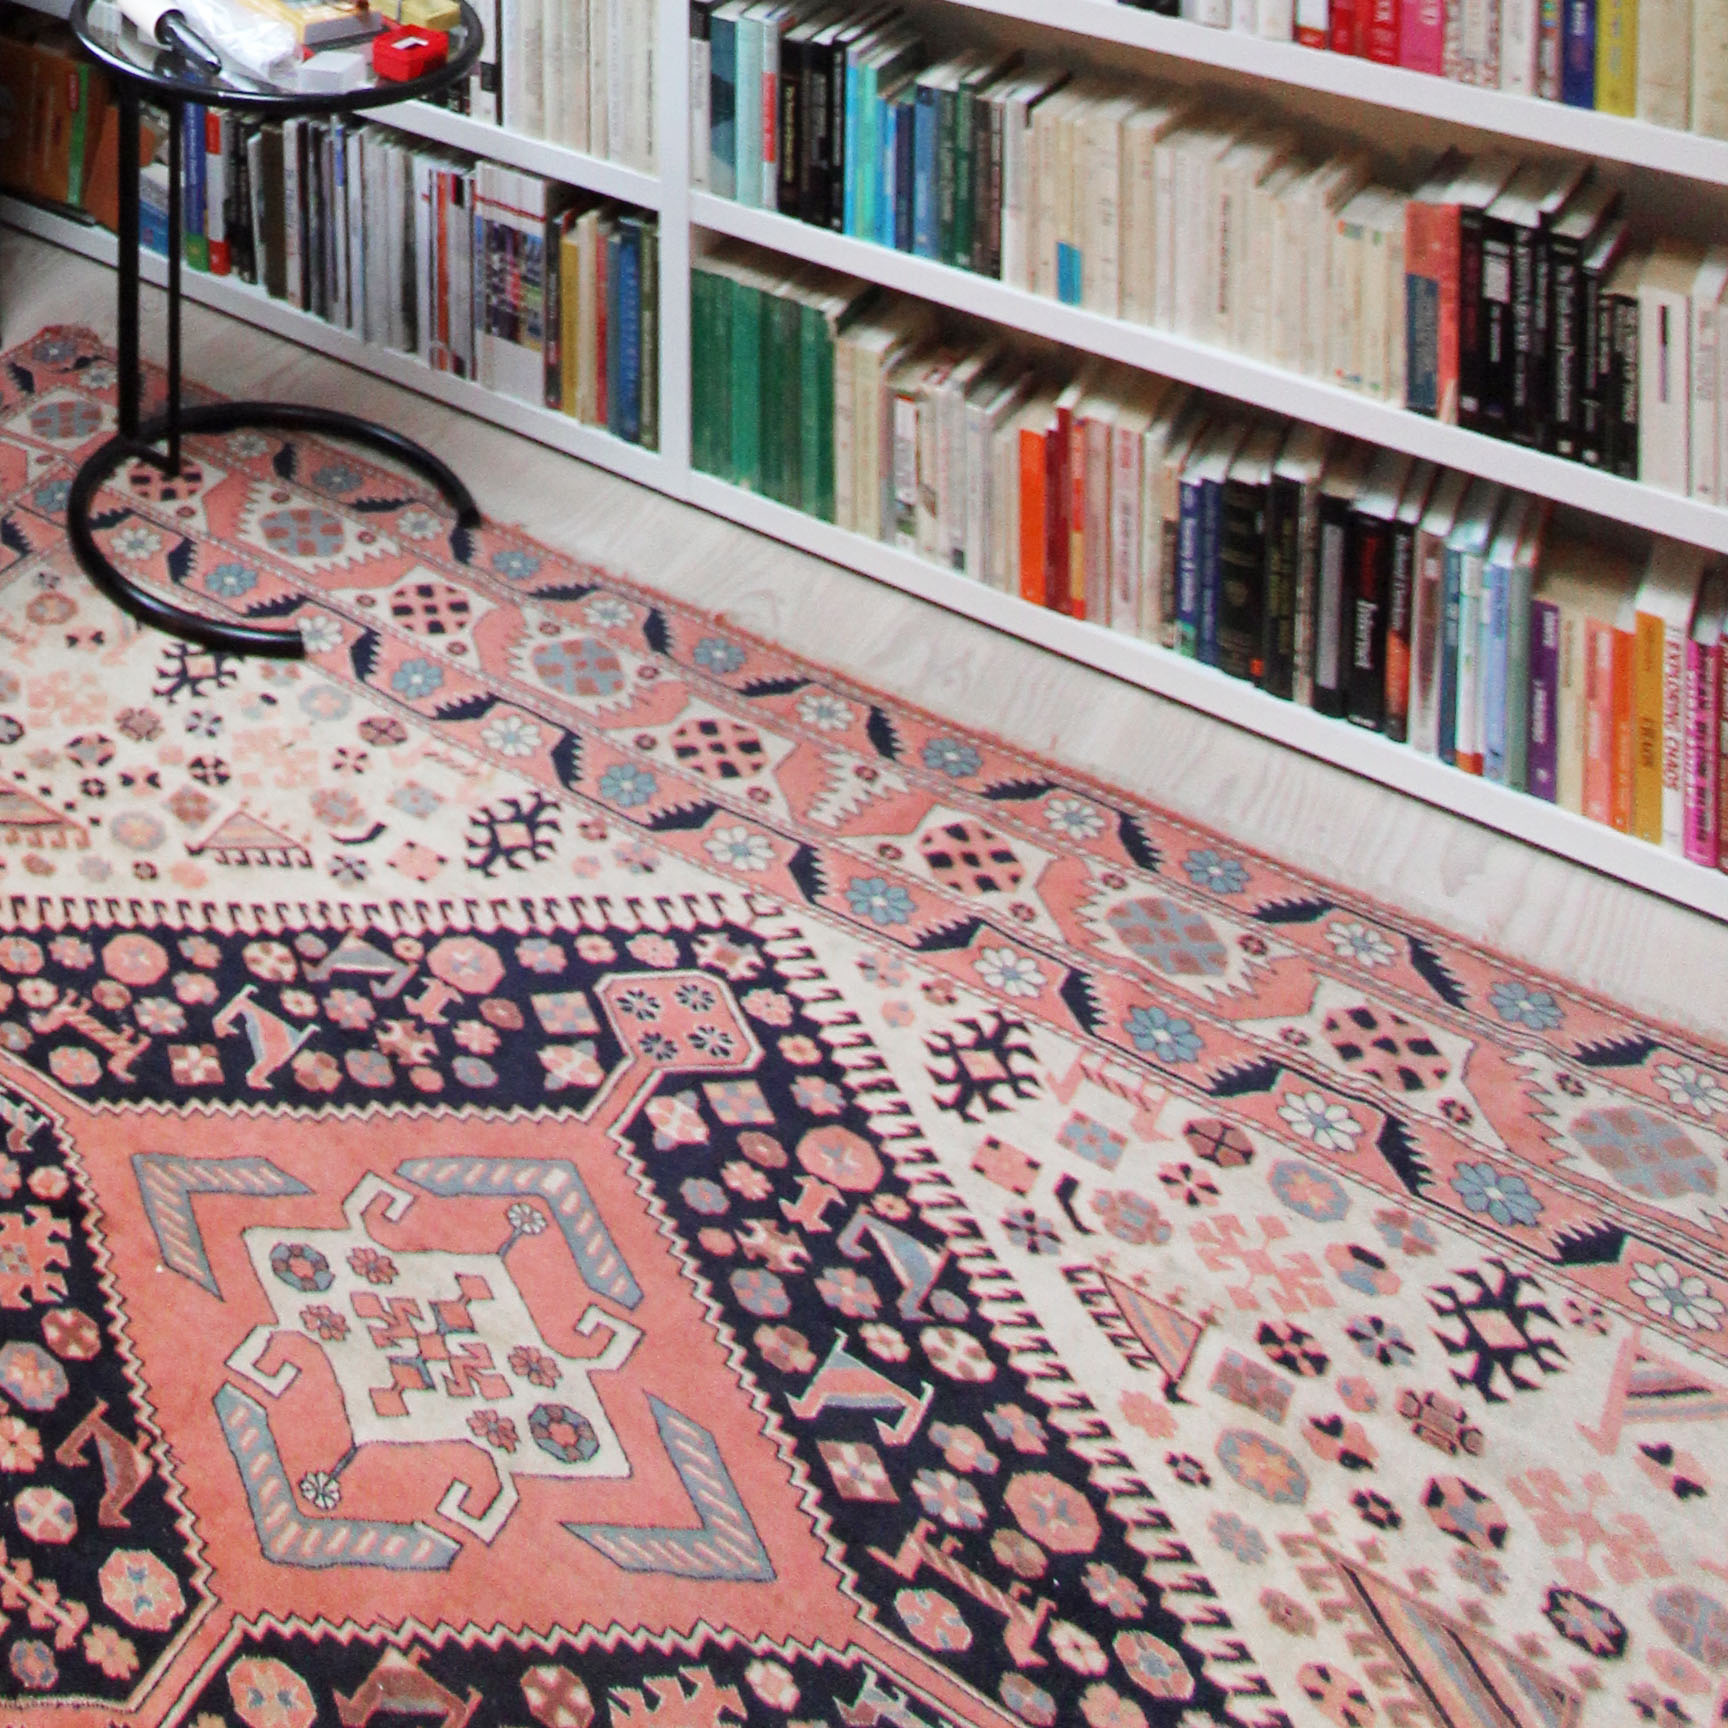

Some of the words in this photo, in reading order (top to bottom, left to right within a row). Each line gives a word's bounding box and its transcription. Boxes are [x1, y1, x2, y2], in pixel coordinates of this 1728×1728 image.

[1353, 598, 1379, 669] Internet
[1662, 640, 1682, 730] EXPLORING
[1662, 735, 1682, 793] CHAOS
